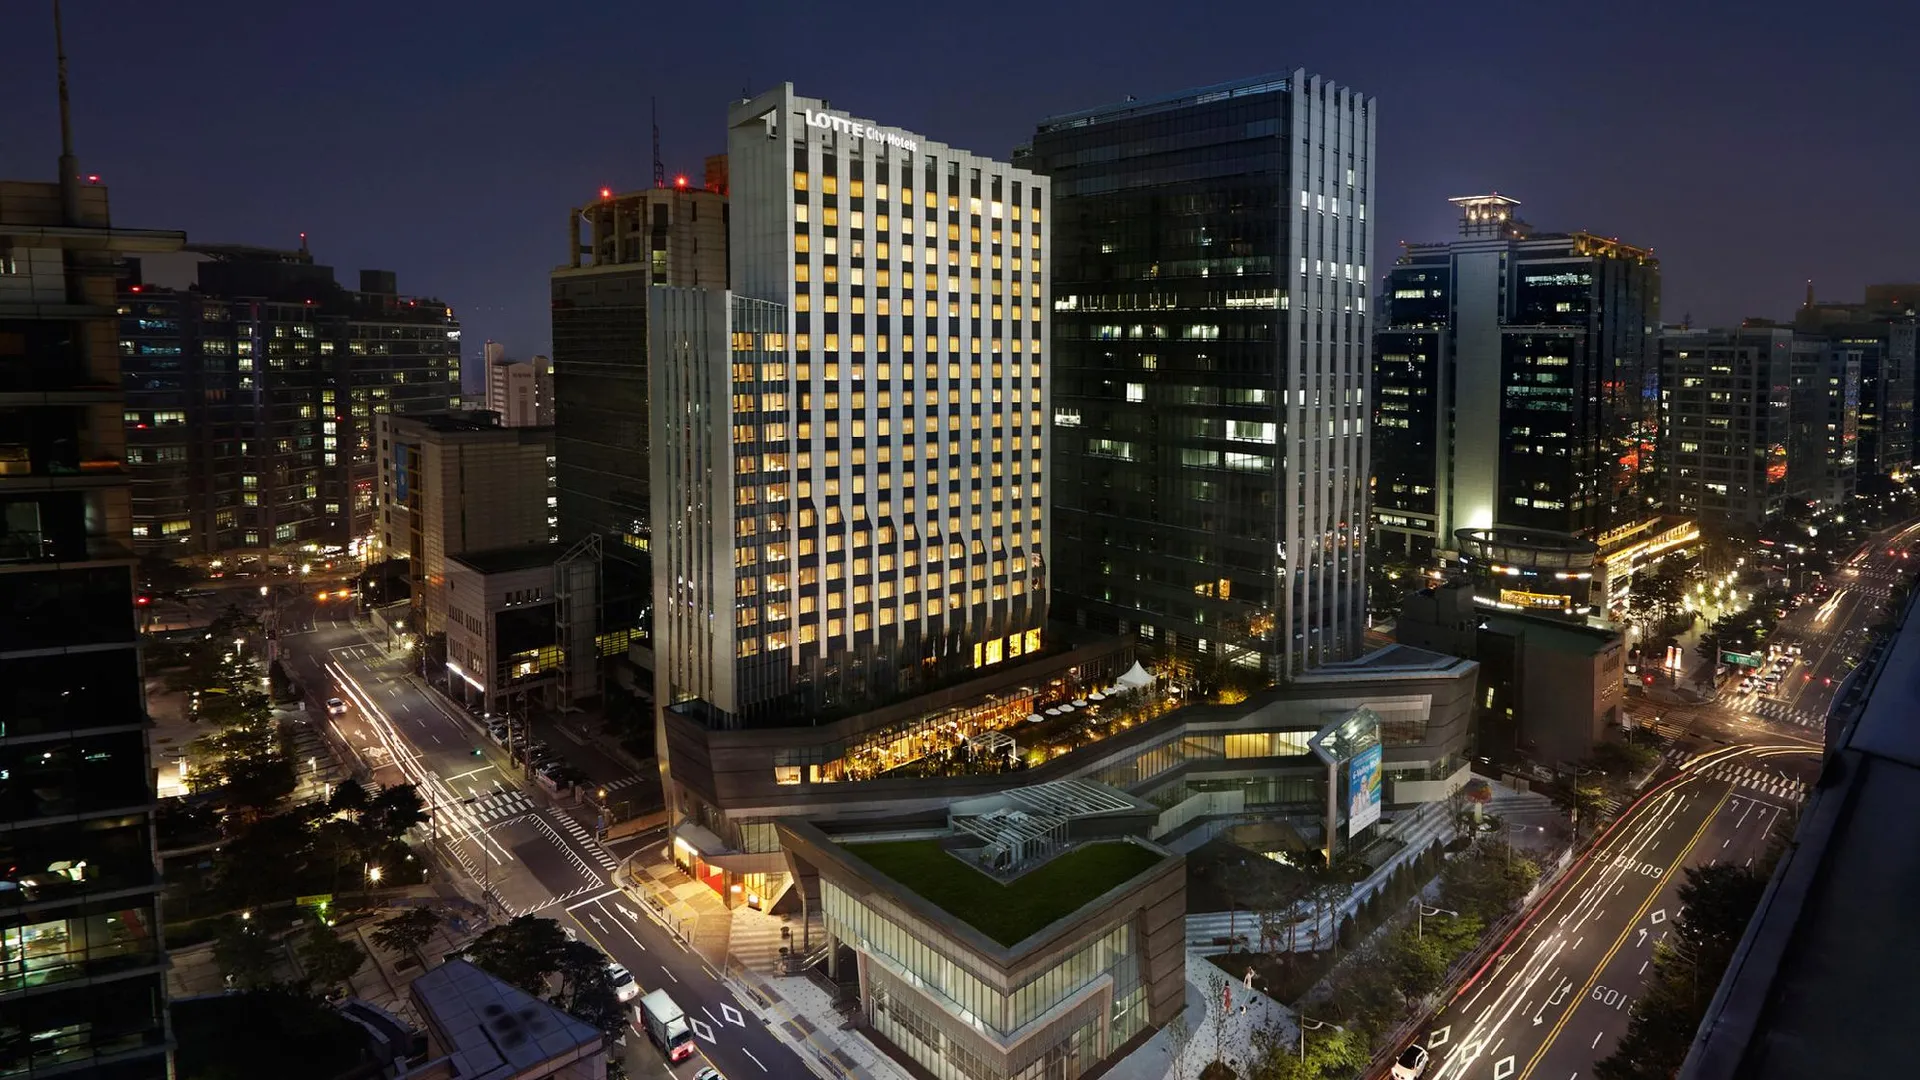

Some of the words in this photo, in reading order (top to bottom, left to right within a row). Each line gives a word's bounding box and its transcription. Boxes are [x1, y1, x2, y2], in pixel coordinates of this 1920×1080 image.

[805, 108, 864, 138] LOTTE
[866, 126, 885, 145] City
[887, 133, 917, 152] Hotels
[1591, 985, 1619, 1006] 60
